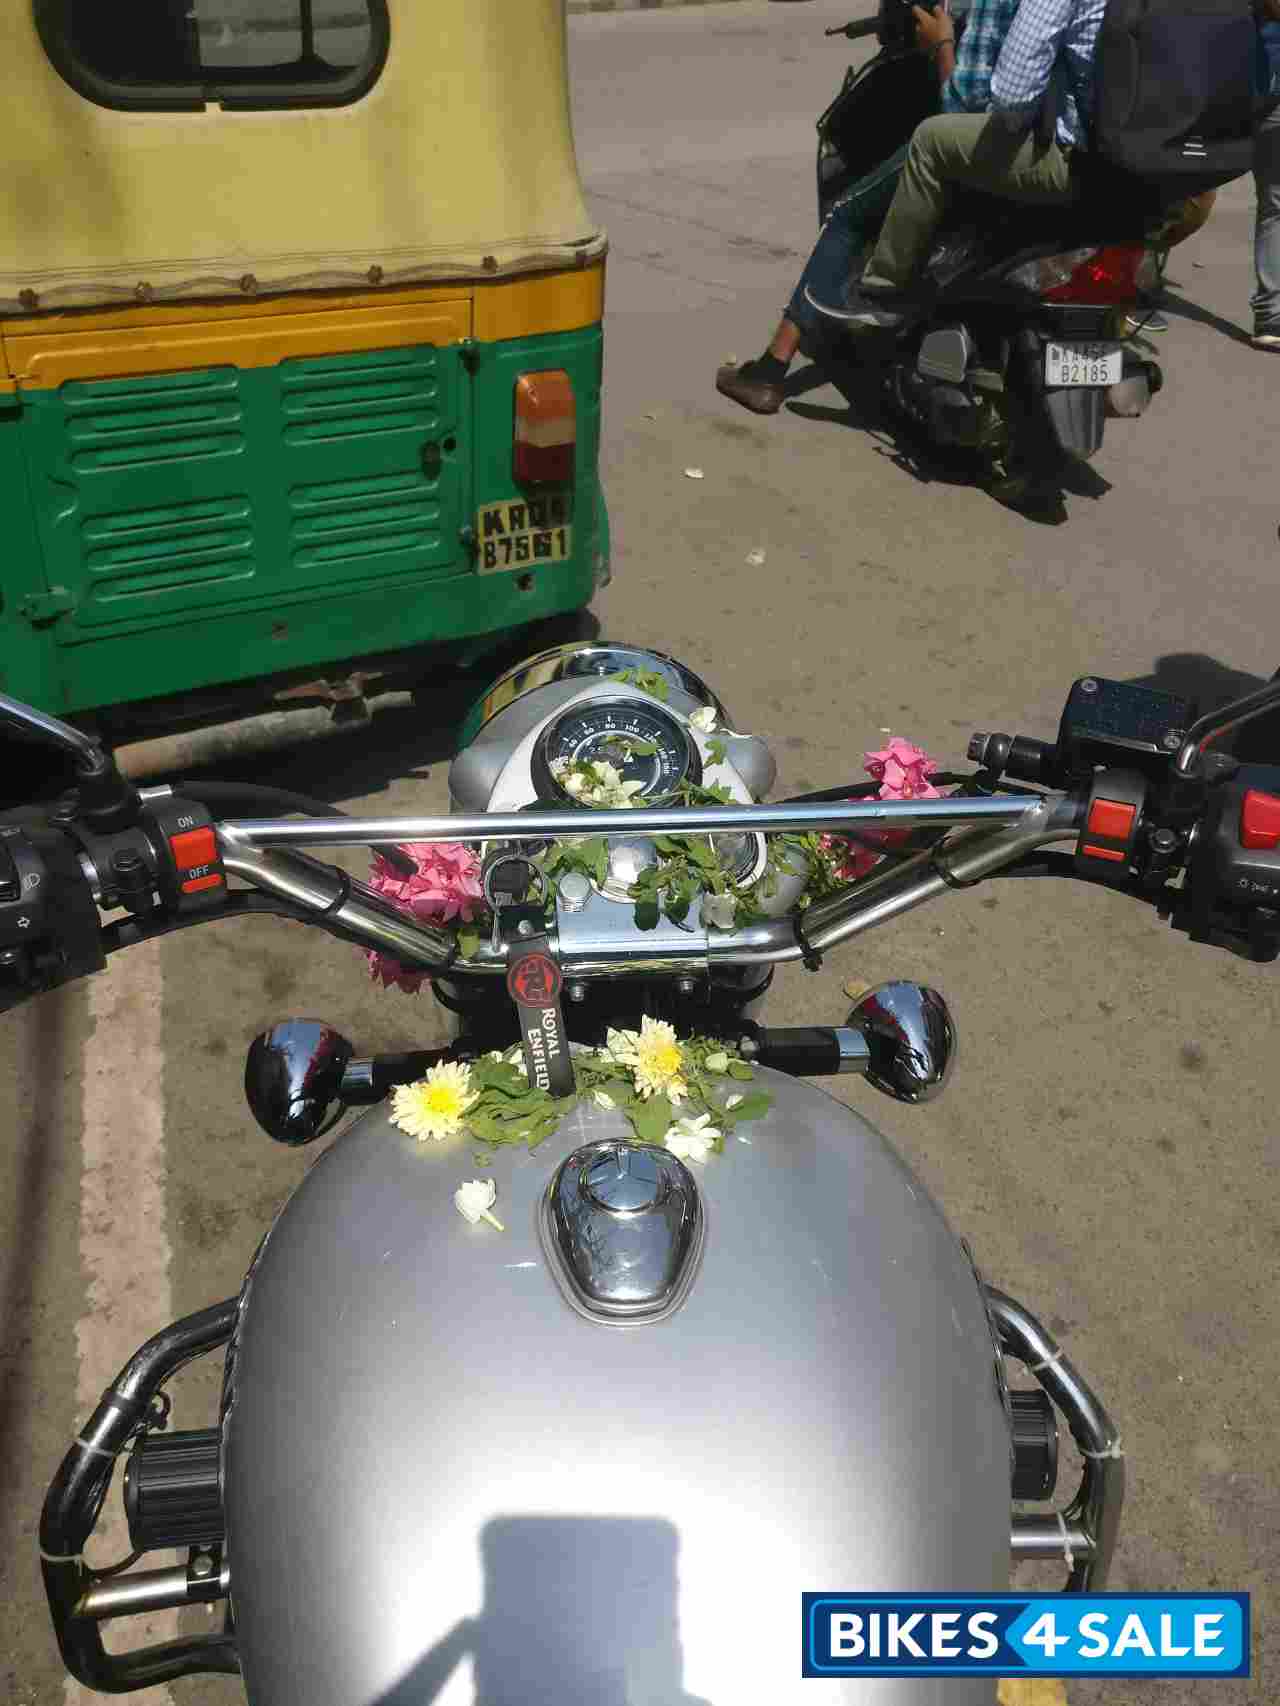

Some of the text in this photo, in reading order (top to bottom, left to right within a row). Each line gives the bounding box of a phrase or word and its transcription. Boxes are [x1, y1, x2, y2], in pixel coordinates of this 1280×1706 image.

[1062, 364, 1108, 383] B2185
[177, 815, 194, 829] ON
[188, 864, 209, 880] OFF
[542, 1007, 561, 1059] ROYAL
[527, 1028, 551, 1091] ENFIELD
